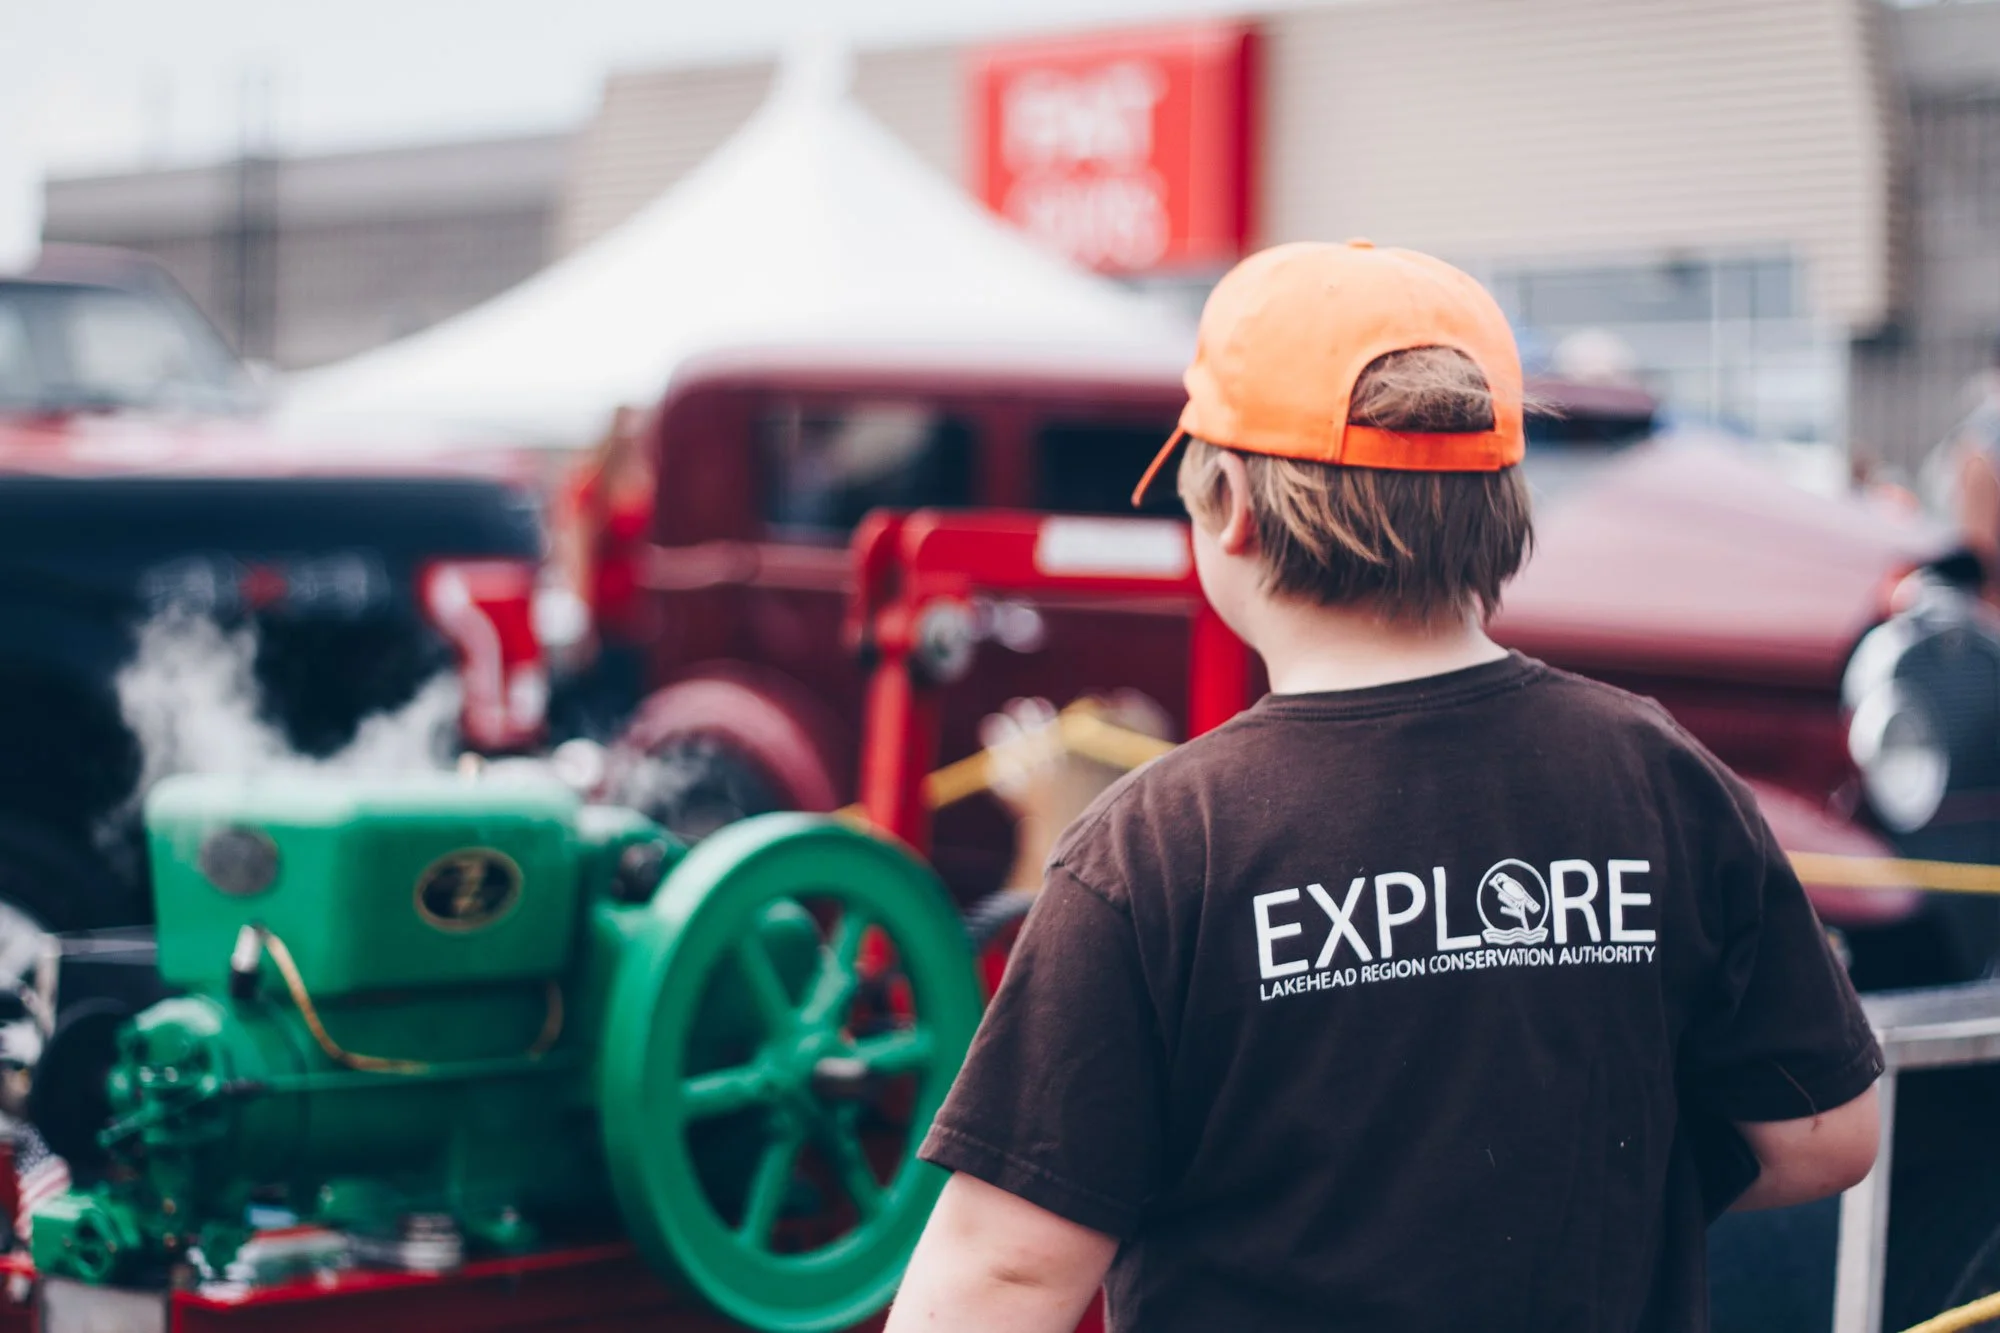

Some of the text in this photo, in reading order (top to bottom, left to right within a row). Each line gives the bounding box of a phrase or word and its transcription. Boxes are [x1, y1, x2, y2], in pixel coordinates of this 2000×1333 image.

[1252, 858, 1657, 980] EXPLORE
[1259, 945, 1657, 1002] LAKEHEAD REGION CONSERVATION AUTHORITY
